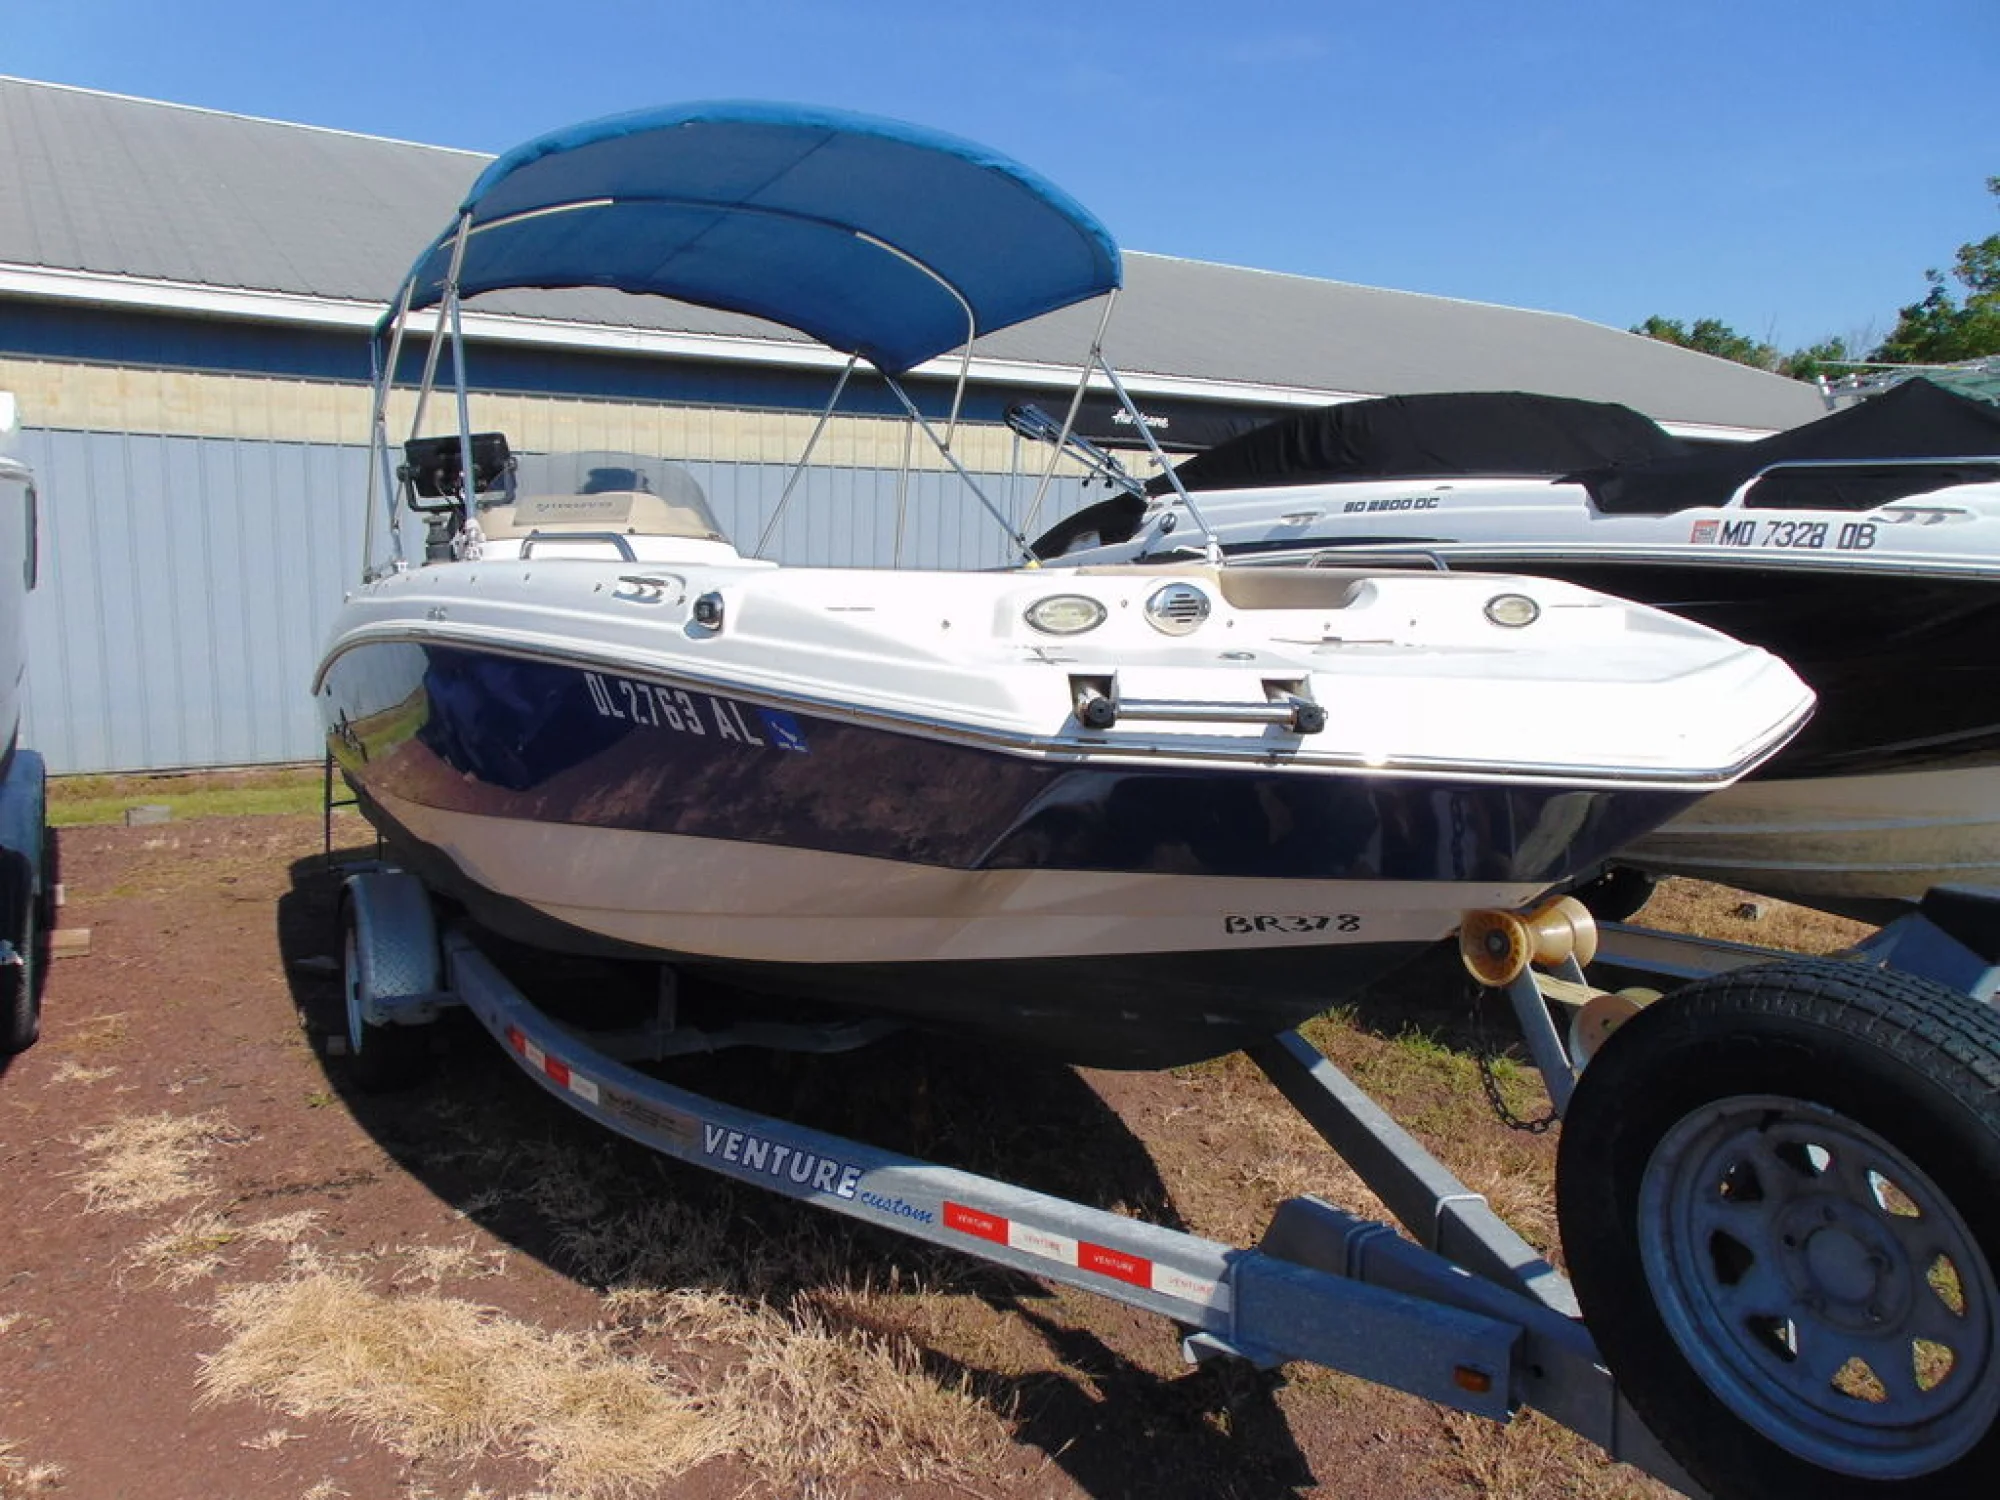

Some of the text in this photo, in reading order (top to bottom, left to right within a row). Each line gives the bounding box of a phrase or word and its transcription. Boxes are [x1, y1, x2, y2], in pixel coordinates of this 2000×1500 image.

[1414, 498, 1441, 509] DC
[1762, 521, 1829, 549] 7328
[618, 680, 706, 736] 2763
[711, 696, 765, 747] AL
[1224, 912, 1361, 934] BR378
[703, 1121, 934, 1225] VENTURE custom
[956, 1213, 1214, 1293] VENTURE VENTURE VENTURE VENTURE
